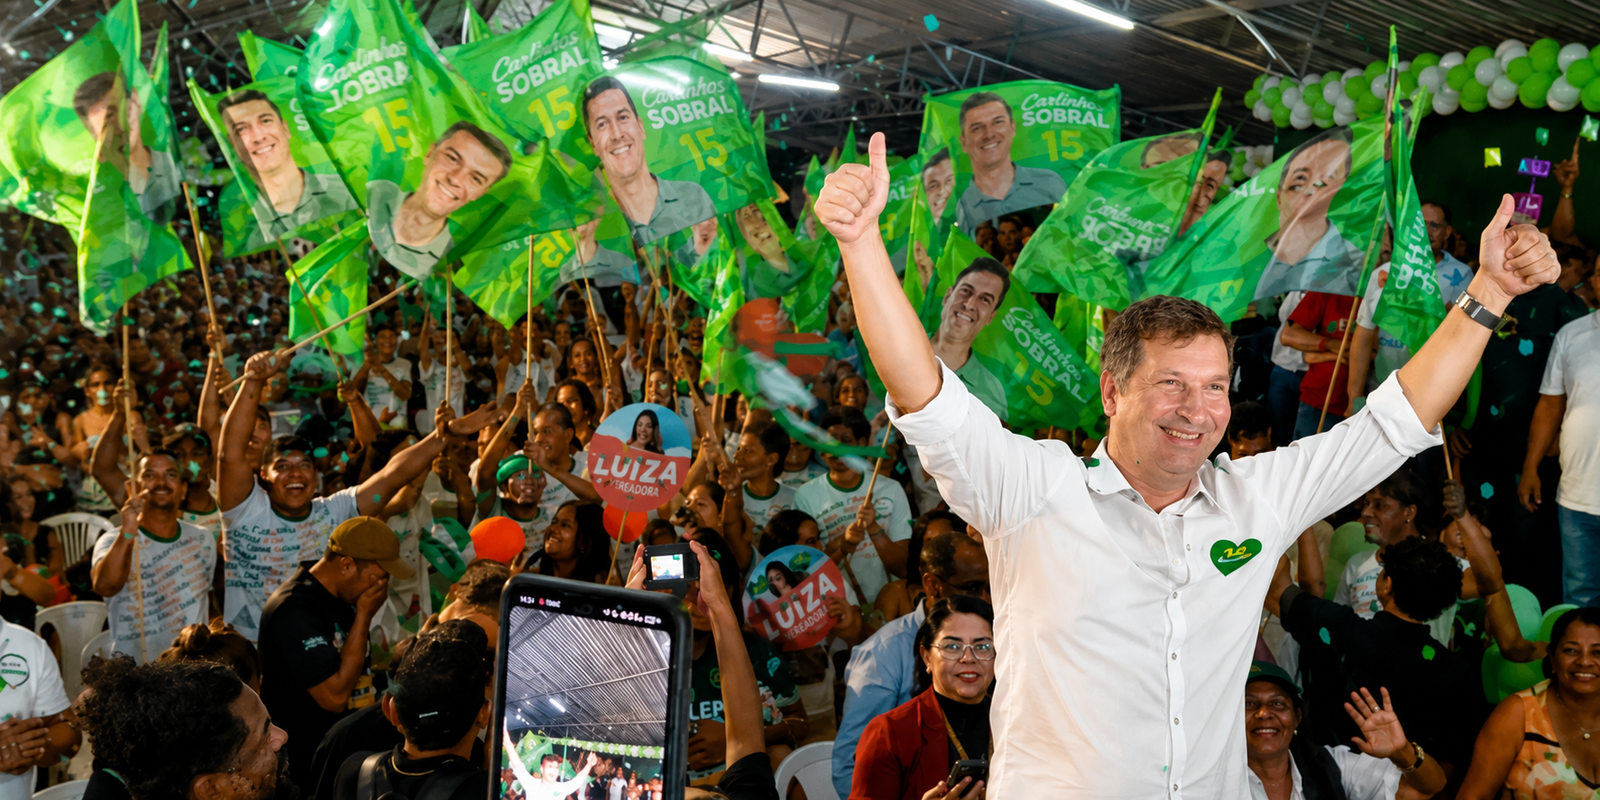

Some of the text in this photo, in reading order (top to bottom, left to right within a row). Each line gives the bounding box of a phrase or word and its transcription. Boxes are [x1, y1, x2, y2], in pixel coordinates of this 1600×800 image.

[492, 31, 579, 82] Carlinhos
[496, 46, 589, 104] SOBRAL
[361, 97, 411, 154] 15
[527, 85, 578, 139] 15
[646, 95, 734, 129] SOBRAL
[1021, 92, 1104, 112] Carlinhos
[1021, 107, 1110, 129] SOBRAL
[678, 126, 728, 172] 15
[1041, 130, 1084, 162] 15
[1002, 312, 1088, 404] SOBRAL
[1009, 306, 1082, 381] Carlinhos
[1012, 351, 1056, 406] 15
[593, 455, 677, 485] LUIZA
[609, 478, 659, 497] VEREADORA
[763, 572, 837, 641] LUIZA
